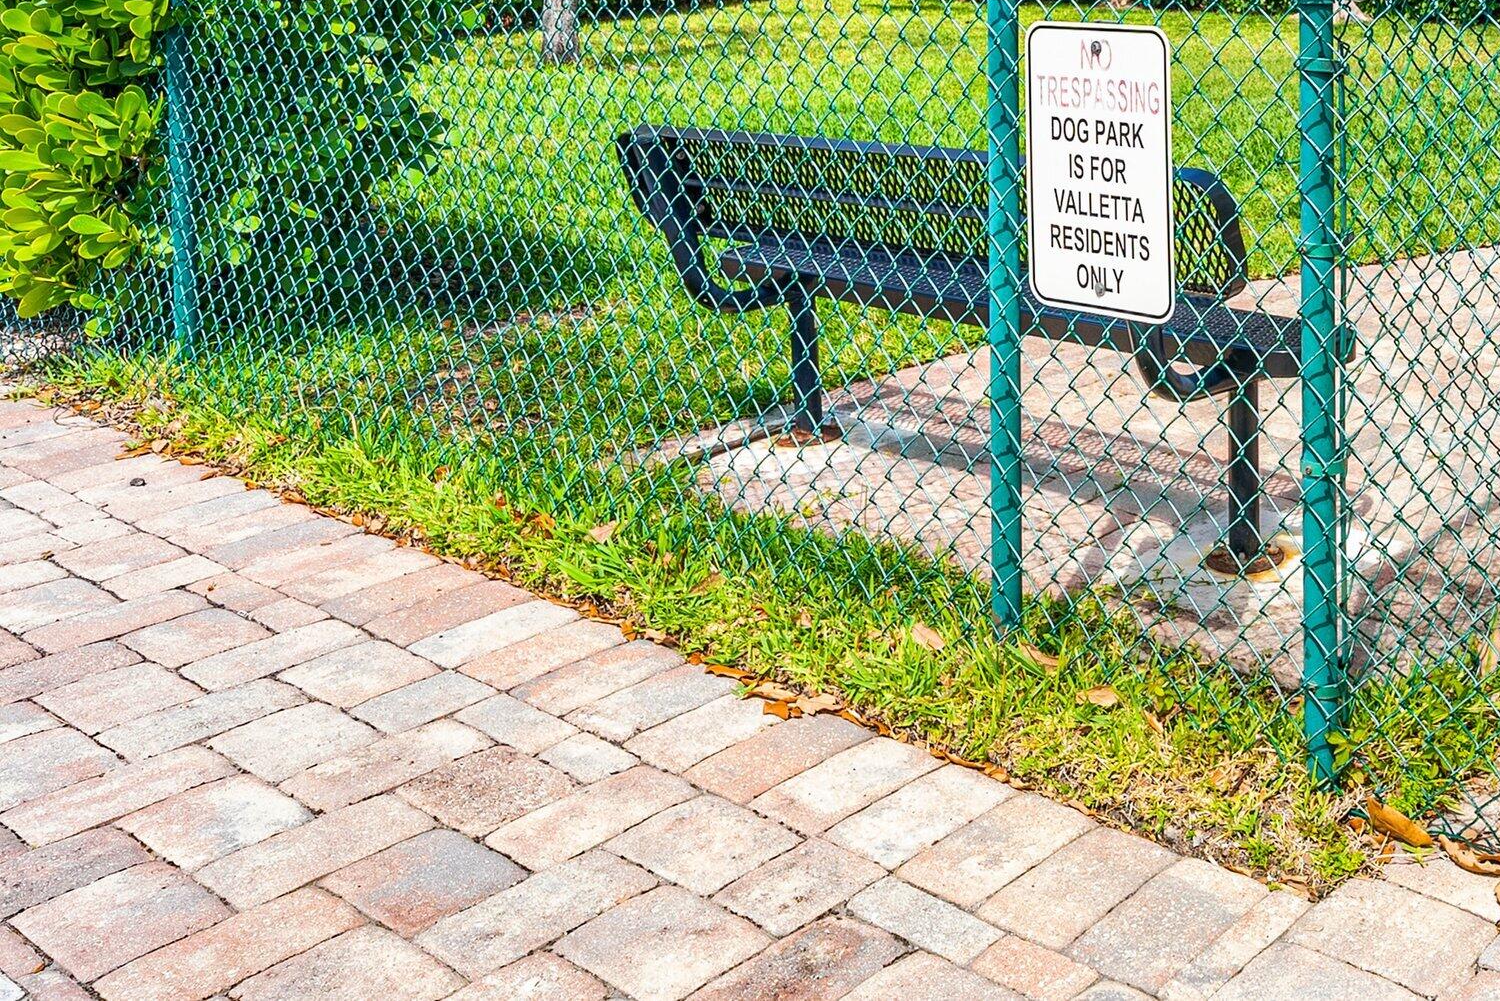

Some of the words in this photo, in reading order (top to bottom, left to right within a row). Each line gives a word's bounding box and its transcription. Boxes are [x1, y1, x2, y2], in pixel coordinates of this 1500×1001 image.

[1080, 39, 1113, 71] NO
[1037, 75, 1160, 115] TRESPASSING
[1051, 116, 1089, 144] DOG
[1095, 120, 1144, 149] PARK
[1069, 154, 1084, 179] IS
[1090, 156, 1127, 184] FOR
[1054, 188, 1145, 224] VALLETTA
[1050, 224, 1150, 262] RESIDENTS
[1076, 263, 1124, 294] ONLY
